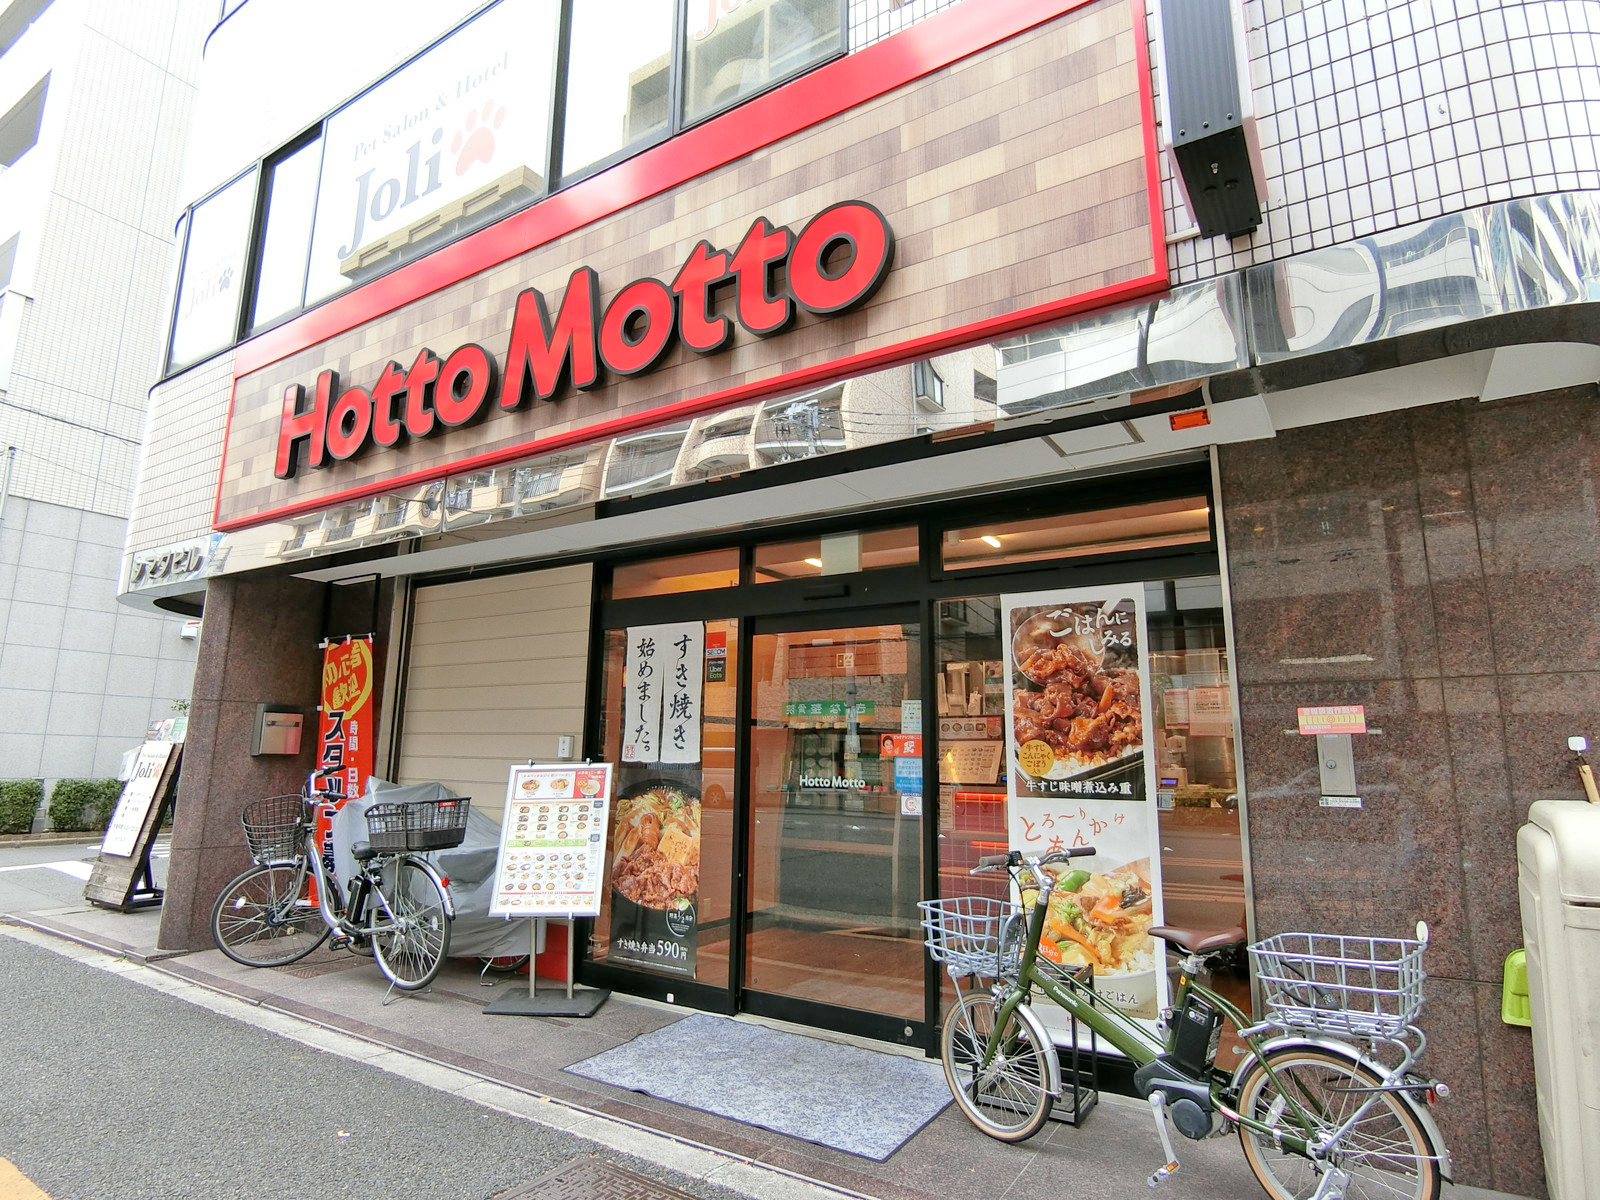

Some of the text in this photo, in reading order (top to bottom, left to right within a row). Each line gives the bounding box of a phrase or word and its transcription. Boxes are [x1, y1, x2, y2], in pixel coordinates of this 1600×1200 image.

[382, 107, 429, 144] Salon
[456, 51, 509, 99] Hotel
[337, 127, 443, 259] Joli
[274, 200, 895, 479] Hotto Motto
[1046, 607, 1129, 638] ごはんに
[1088, 629, 1133, 655] しみる
[635, 637, 656, 752] 始めました。
[669, 634, 693, 750] すき焼き
[1022, 751, 1050, 760] こんにゃく
[1026, 760, 1047, 768] ごぼう
[131, 762, 154, 782] Joli
[800, 774, 866, 788] Hotto Motto
[1025, 780, 1132, 795] 牛すじ味噌煮込み重
[1052, 985, 1079, 1008] Panasonic
